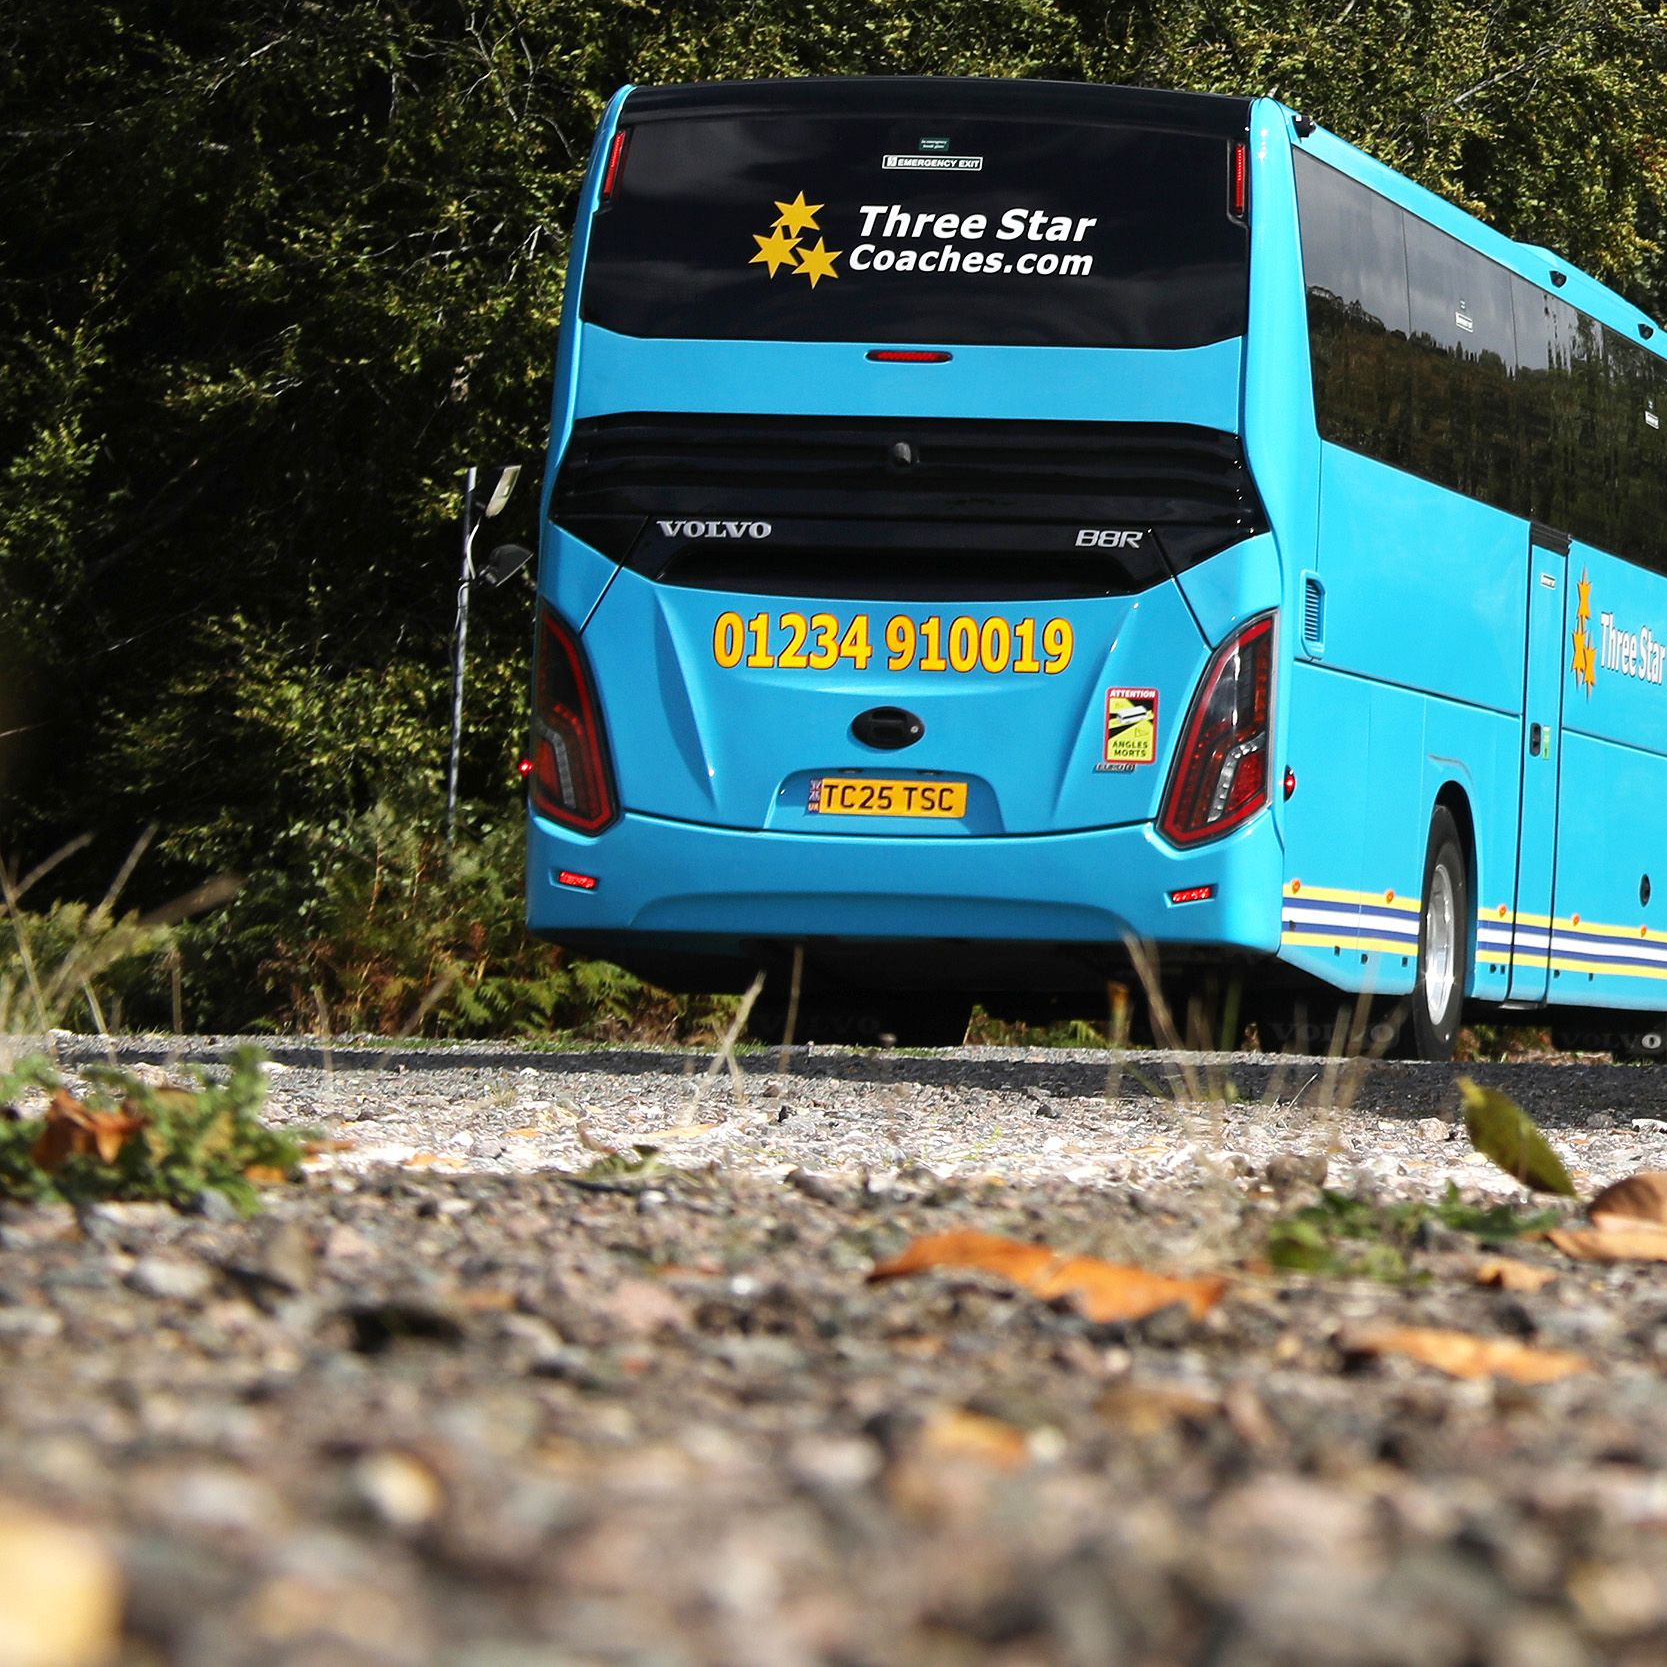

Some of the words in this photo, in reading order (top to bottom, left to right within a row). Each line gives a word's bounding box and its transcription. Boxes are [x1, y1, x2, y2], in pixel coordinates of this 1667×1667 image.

[897, 159, 957, 168] EMERGENCY
[958, 160, 980, 168] EXIT
[858, 204, 988, 240] Three
[995, 207, 1098, 242] Star
[848, 243, 1094, 276] Coaches.com
[656, 520, 772, 539] VOLVO
[1075, 529, 1143, 549] B8R
[713, 611, 873, 670] 01234
[885, 614, 1075, 675] 910019
[1600, 611, 1637, 678] Three
[1638, 625, 1666, 686] Star
[1109, 689, 1156, 699] ATTENTION
[1112, 740, 1148, 750] ANGLES
[1113, 749, 1147, 758] MORTS
[824, 785, 893, 811] TC25
[903, 787, 955, 812] TSC
